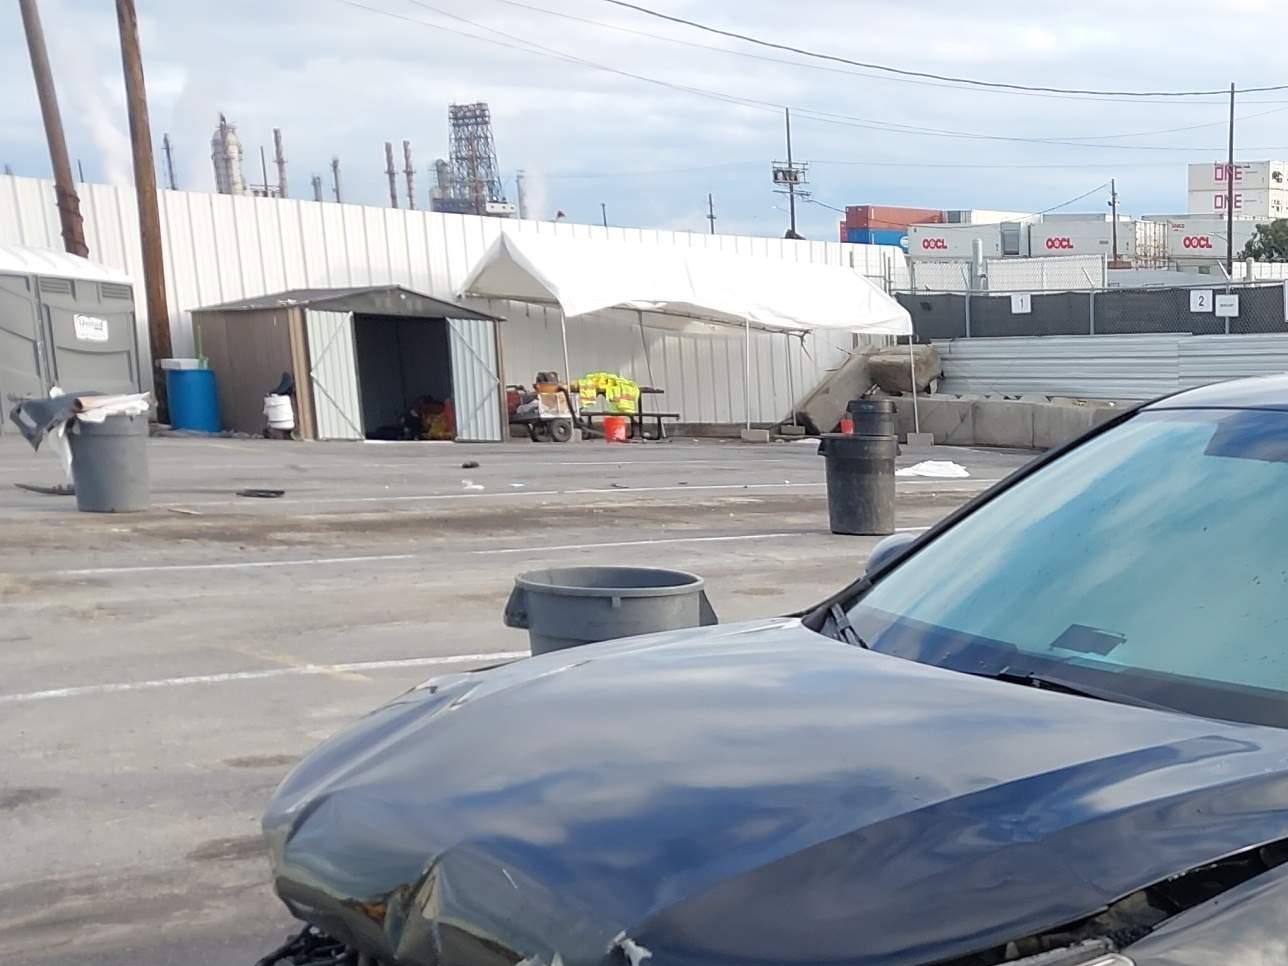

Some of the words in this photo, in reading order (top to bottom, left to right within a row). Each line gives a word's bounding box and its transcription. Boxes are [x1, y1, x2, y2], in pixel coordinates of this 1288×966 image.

[922, 238, 947, 249] OOCL
[1046, 238, 1074, 249] OOCL
[1183, 236, 1212, 249] OOCL
[1198, 295, 1205, 307] 2
